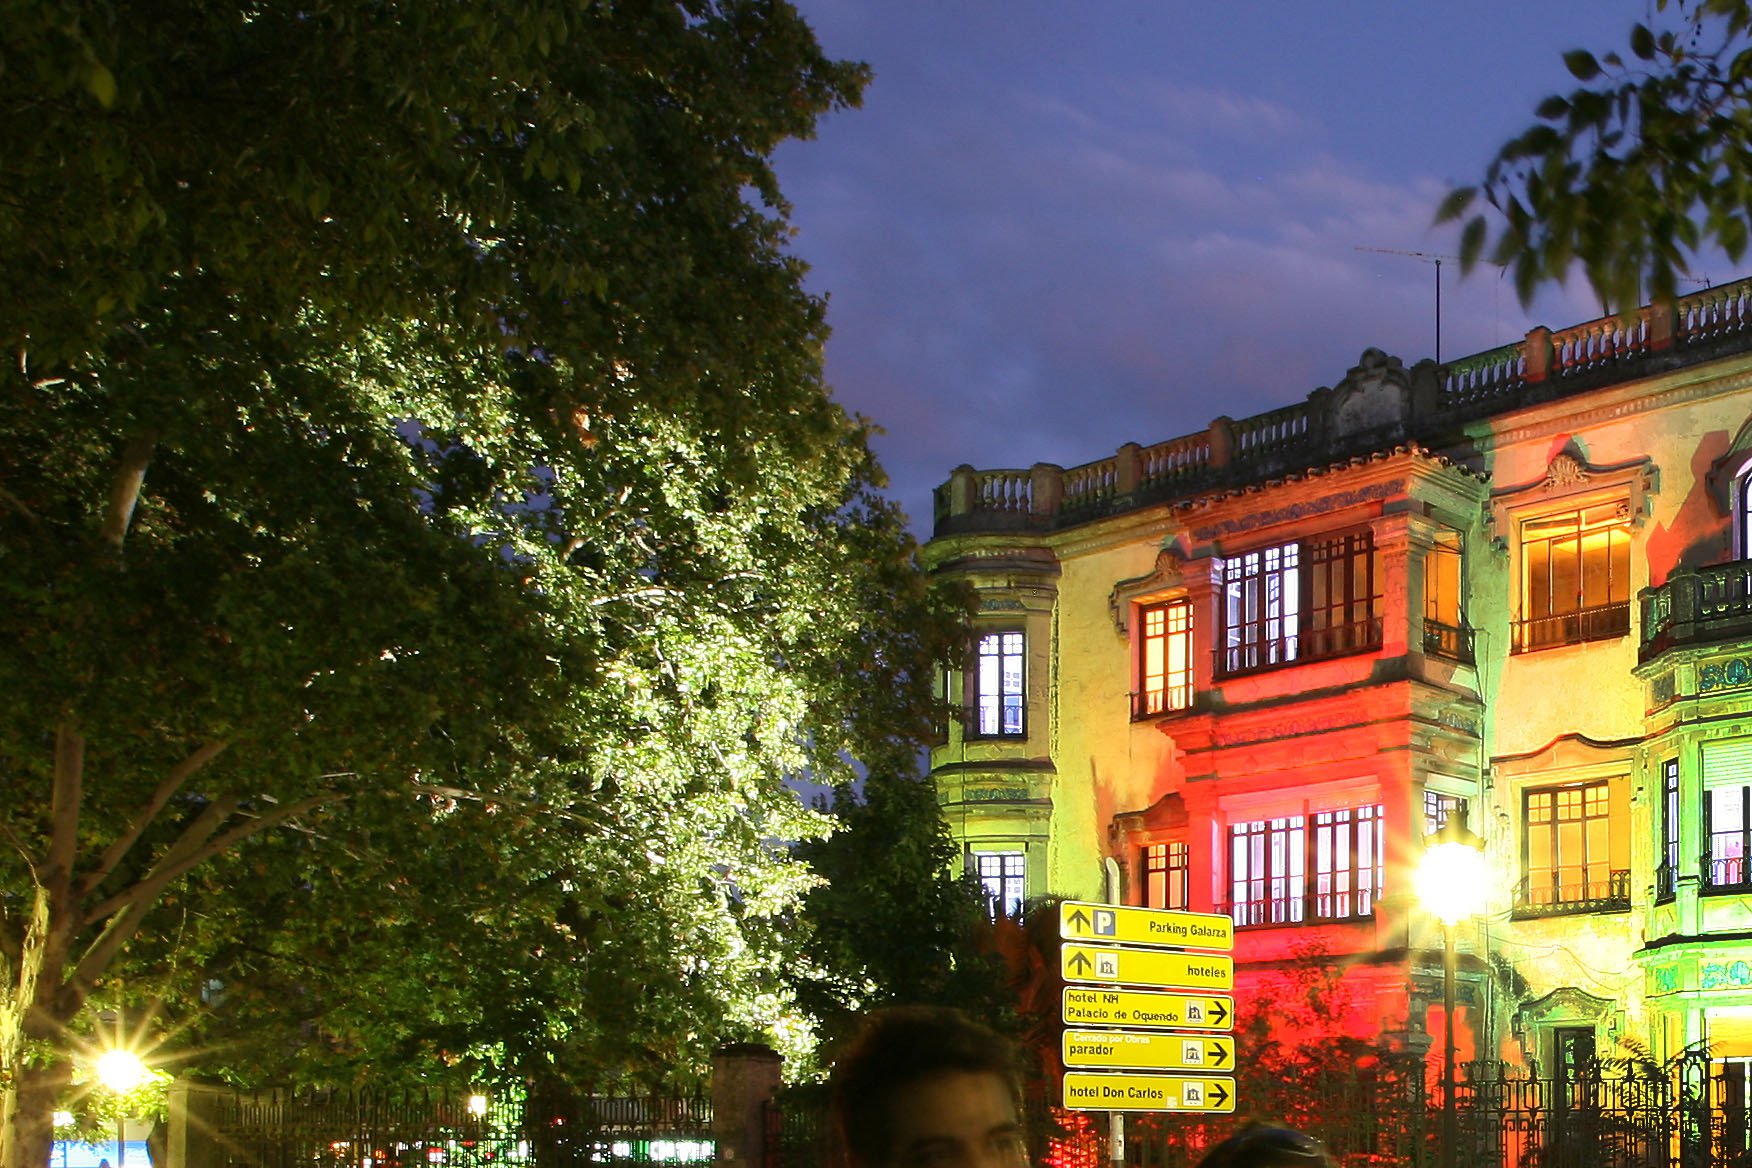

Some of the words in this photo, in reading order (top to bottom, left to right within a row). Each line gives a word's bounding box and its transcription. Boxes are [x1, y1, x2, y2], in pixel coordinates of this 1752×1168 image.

[1150, 920, 1187, 938] Parking
[1190, 924, 1227, 938] Galarza
[1187, 965, 1227, 979] hoteles
[1068, 992, 1098, 1004] hotel
[1103, 994, 1119, 1005] NH
[1068, 1007, 1109, 1020] Palacio
[1114, 1010, 1127, 1020] de
[1133, 1010, 1179, 1023] Oquendo
[1069, 1043, 1114, 1057] parador
[1070, 1086, 1099, 1098] hotel
[1103, 1086, 1125, 1099] Don
[1128, 1087, 1164, 1099] Carlos
